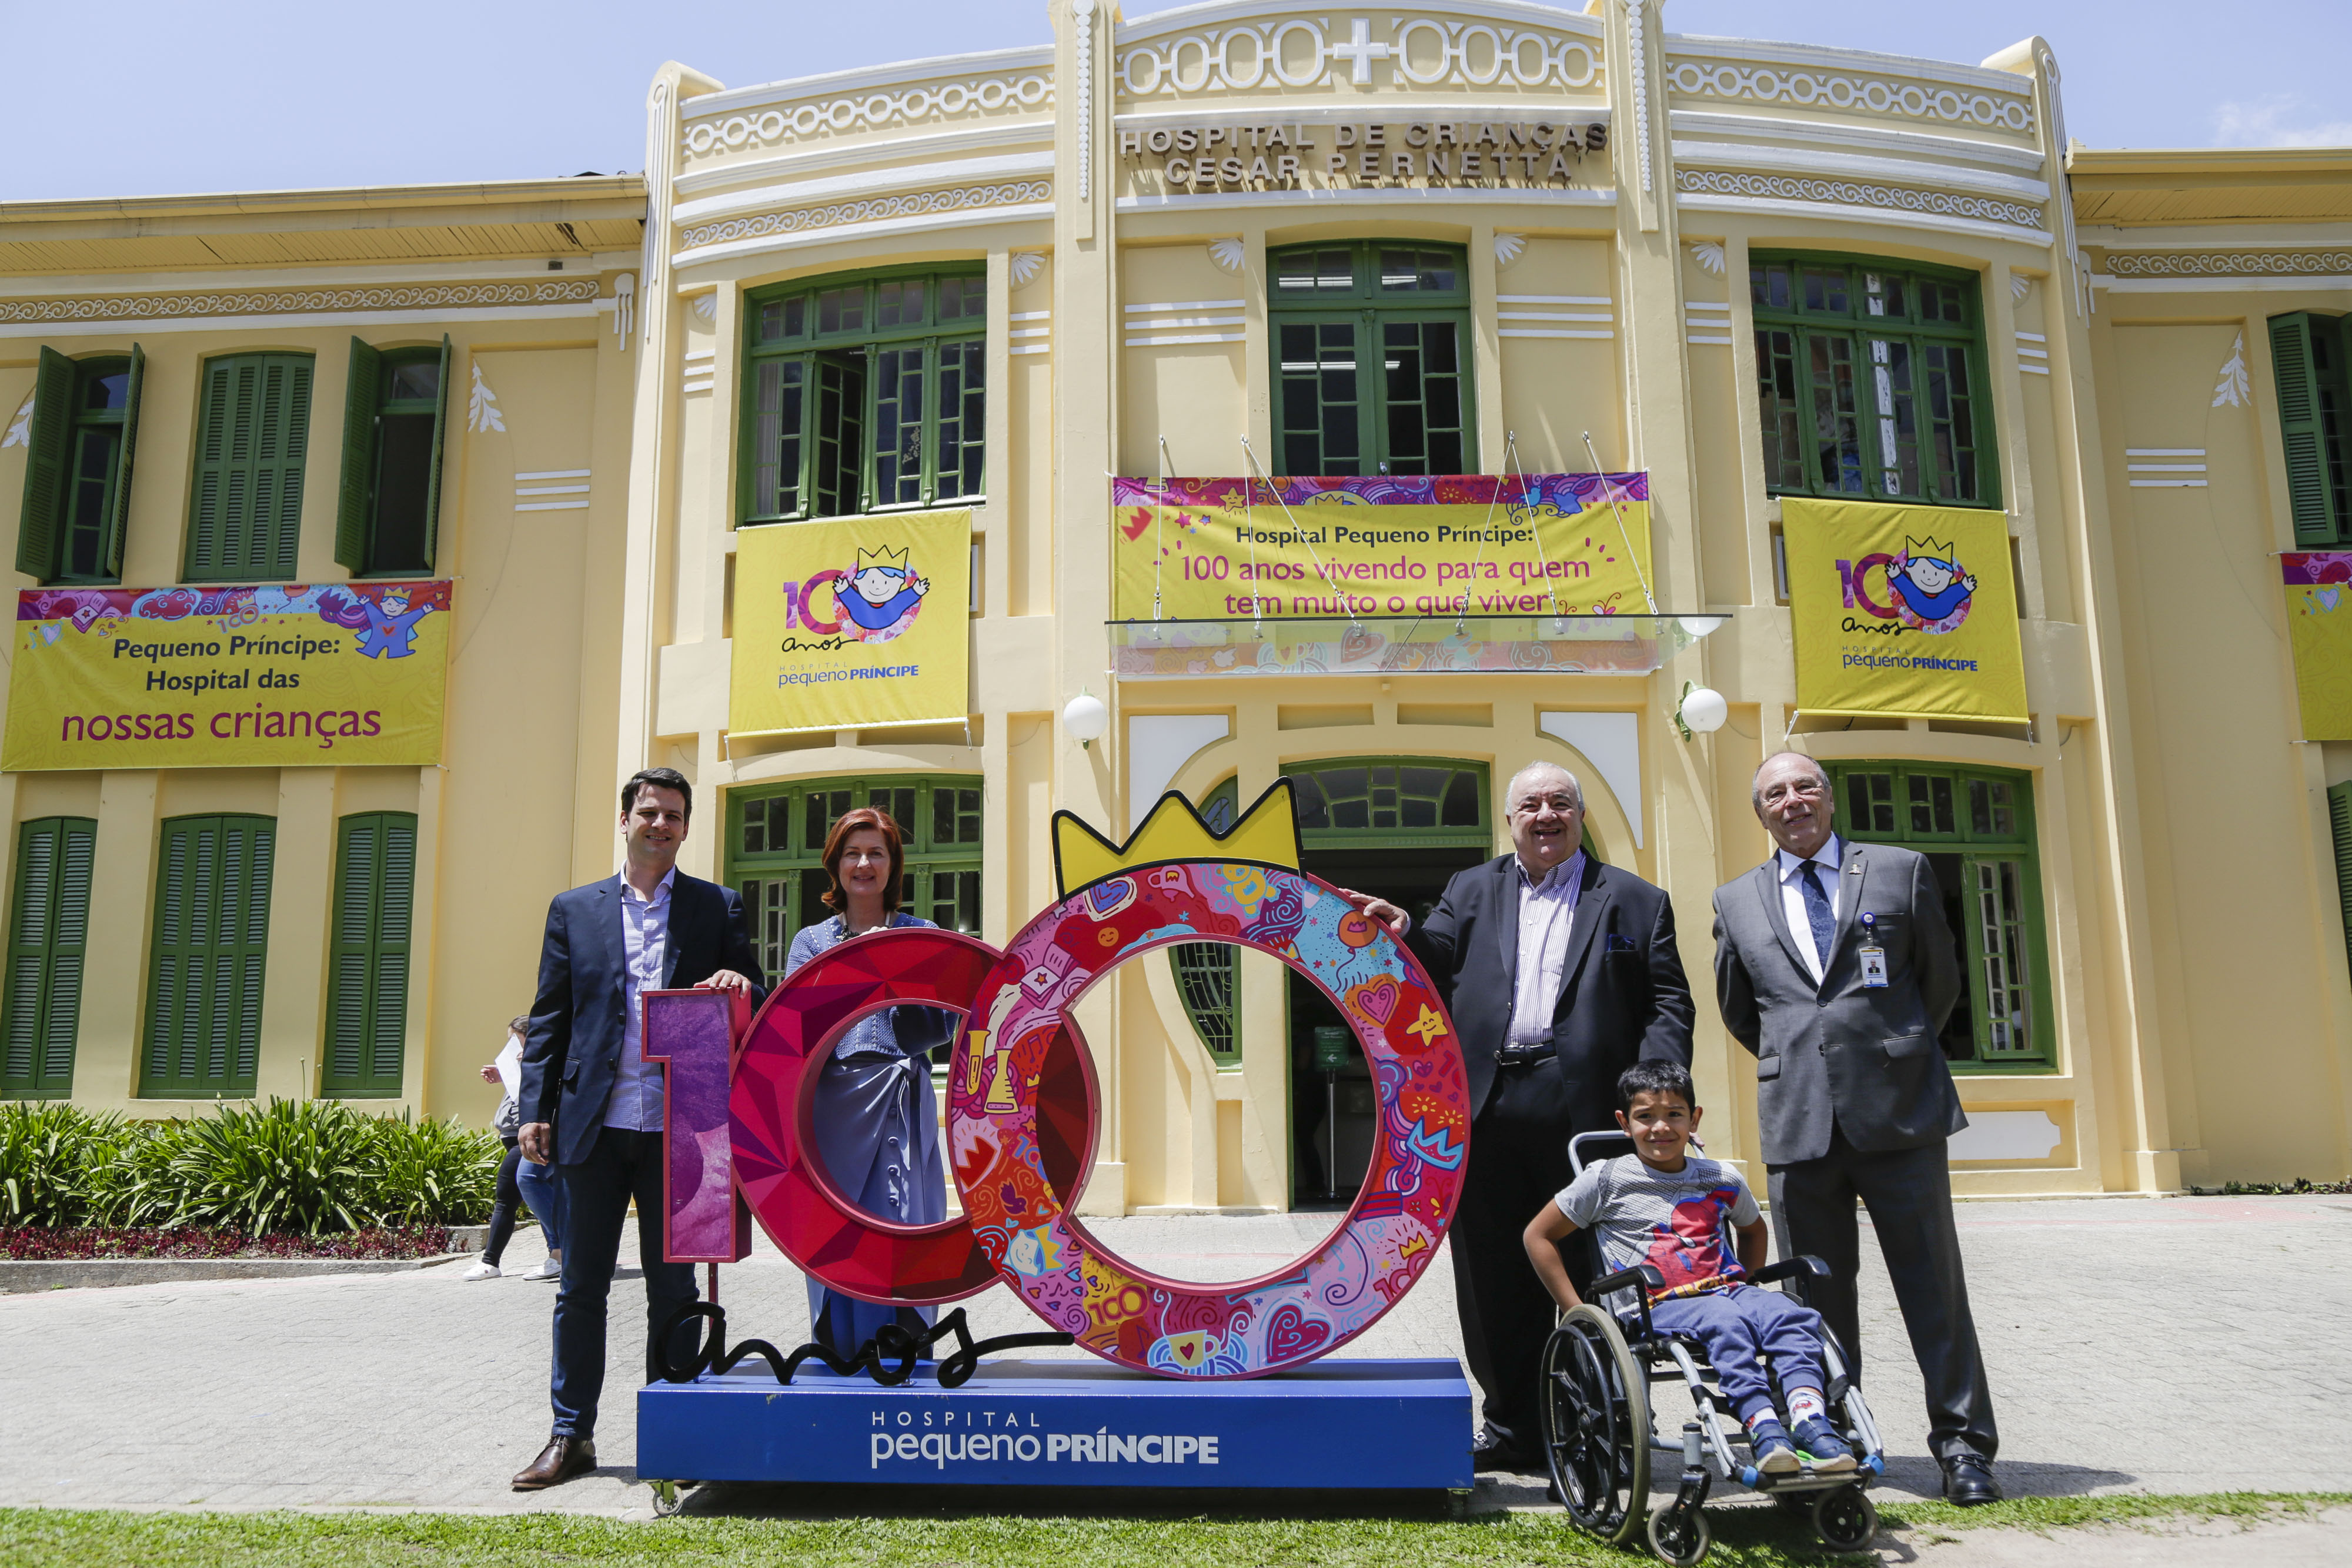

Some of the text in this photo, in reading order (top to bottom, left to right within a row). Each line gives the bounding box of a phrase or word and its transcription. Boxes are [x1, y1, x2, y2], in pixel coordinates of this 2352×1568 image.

[1120, 121, 1607, 155] HOSPITAL DE CRIANÇAS
[1165, 151, 1572, 186] CESAR PERNETTA
[1237, 525, 1534, 548] Hospital Pequeno Príncipe:
[1181, 554, 1590, 586] 100 anos vivendo para quem
[1224, 589, 1549, 616] tem muito o que viver
[216, 605, 259, 634] 100
[1841, 617, 1918, 636] anos
[113, 634, 340, 664] Pequeno Príncipe:
[781, 636, 860, 652] anos
[1842, 645, 1910, 654] HOSPITAL
[779, 664, 919, 688] pequeno PRÍNCIPE
[780, 661, 848, 672] HOSPITAL
[1843, 654, 1978, 671] pequeno PRÍNCIPE
[146, 668, 300, 696] Hospital das
[62, 702, 381, 749] nossas crianças
[642, 861, 1472, 1382] 100
[1089, 1285, 1150, 1326] 100
[654, 1301, 1075, 1388] anos
[872, 1411, 1040, 1427] HOSPITAL
[871, 1426, 1219, 1469] pequeno PRÍNCIPE
